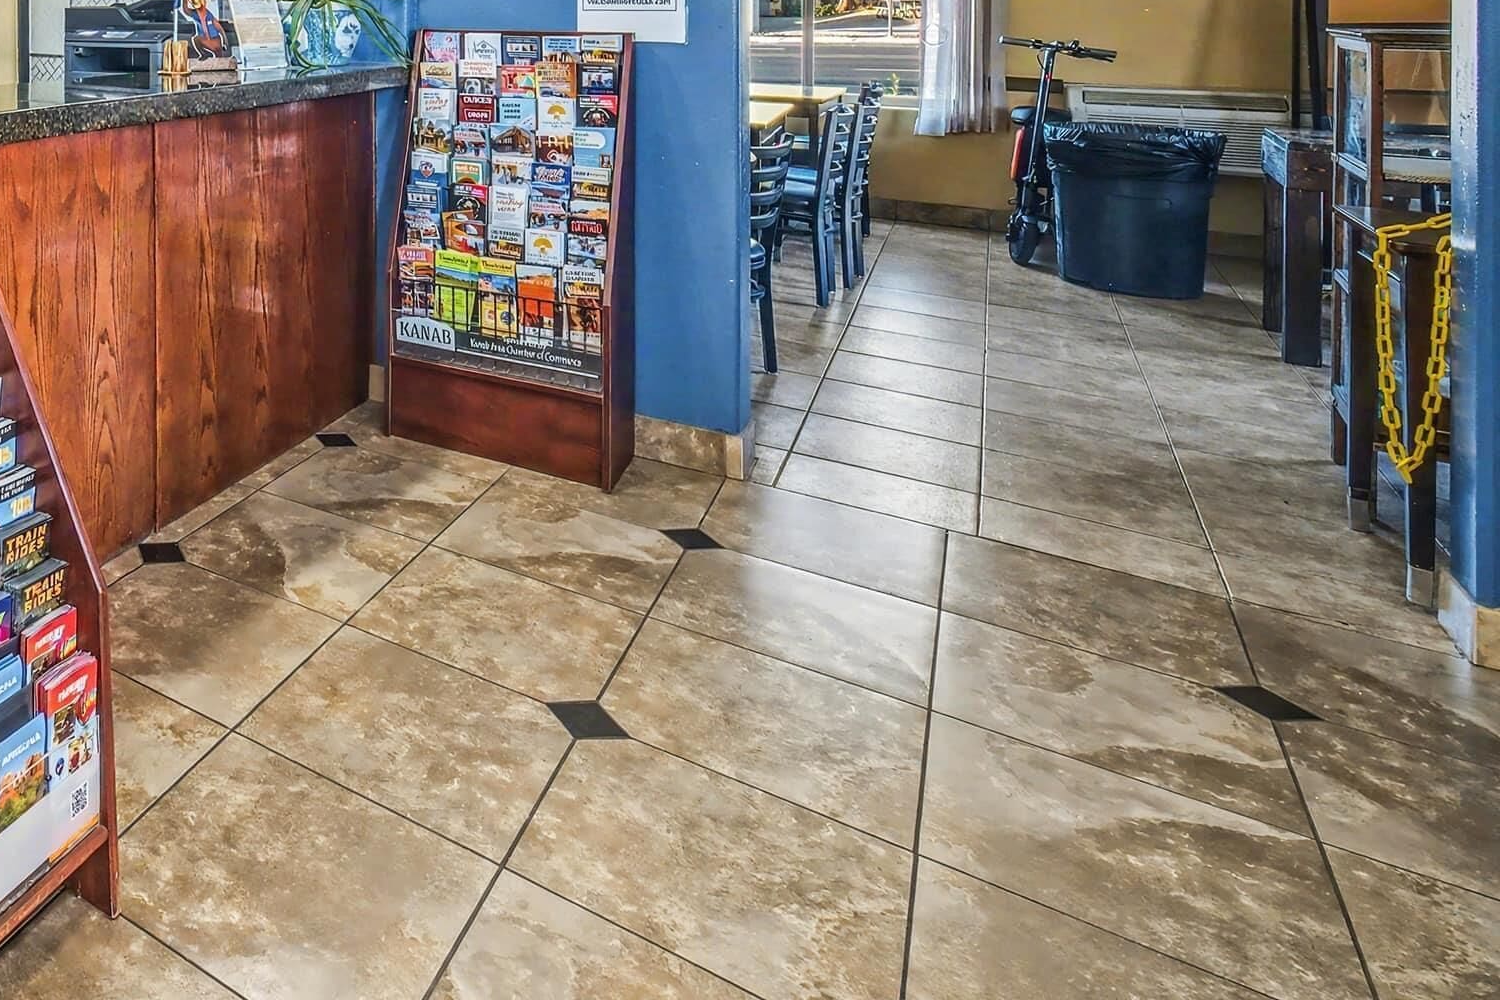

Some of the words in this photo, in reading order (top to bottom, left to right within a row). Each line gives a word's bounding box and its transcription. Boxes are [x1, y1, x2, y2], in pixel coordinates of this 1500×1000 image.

[400, 320, 451, 345] KANAB
[6, 523, 47, 549] TRAIN
[6, 537, 45, 566] RIDES
